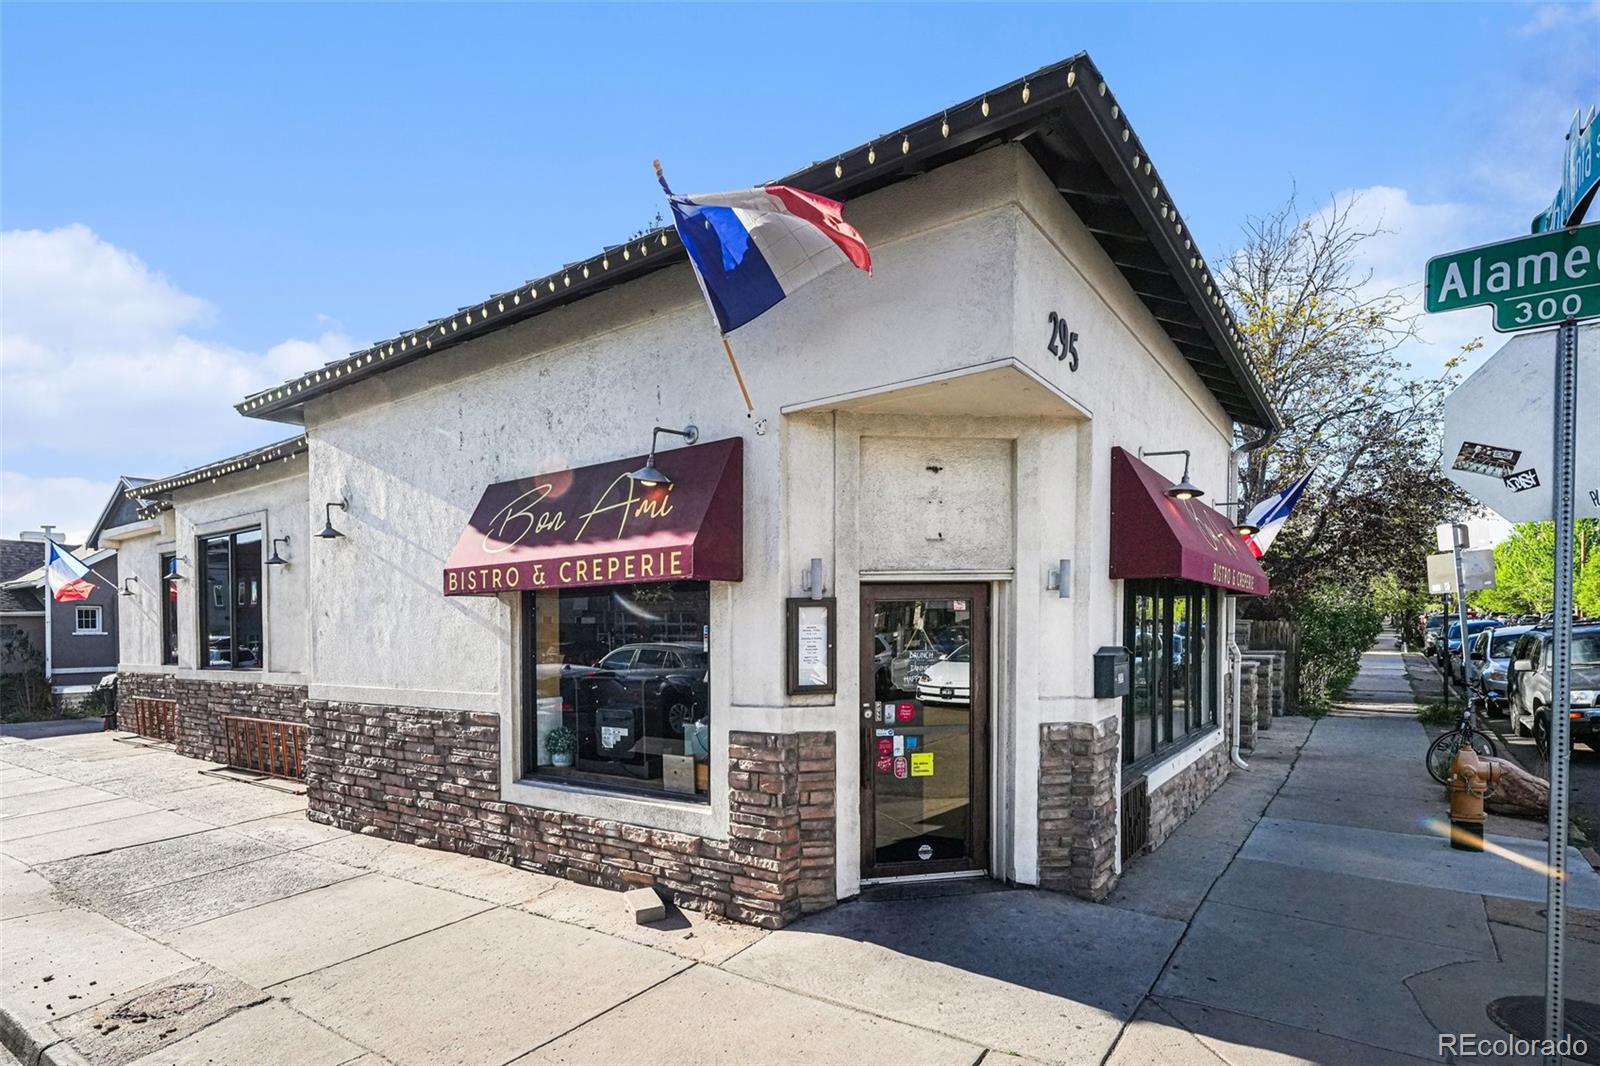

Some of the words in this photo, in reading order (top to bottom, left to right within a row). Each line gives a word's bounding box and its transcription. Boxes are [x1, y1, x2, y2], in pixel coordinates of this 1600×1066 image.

[1438, 245, 1600, 303] Alame
[1515, 294, 1582, 324] 300
[1047, 311, 1079, 373] 295
[482, 484, 566, 554] Bon
[575, 472, 675, 542] Ami
[449, 567, 519, 591] BISTRO
[532, 564, 546, 585] &
[559, 551, 682, 583] CREPERIE
[1212, 562, 1231, 585] BISTRO
